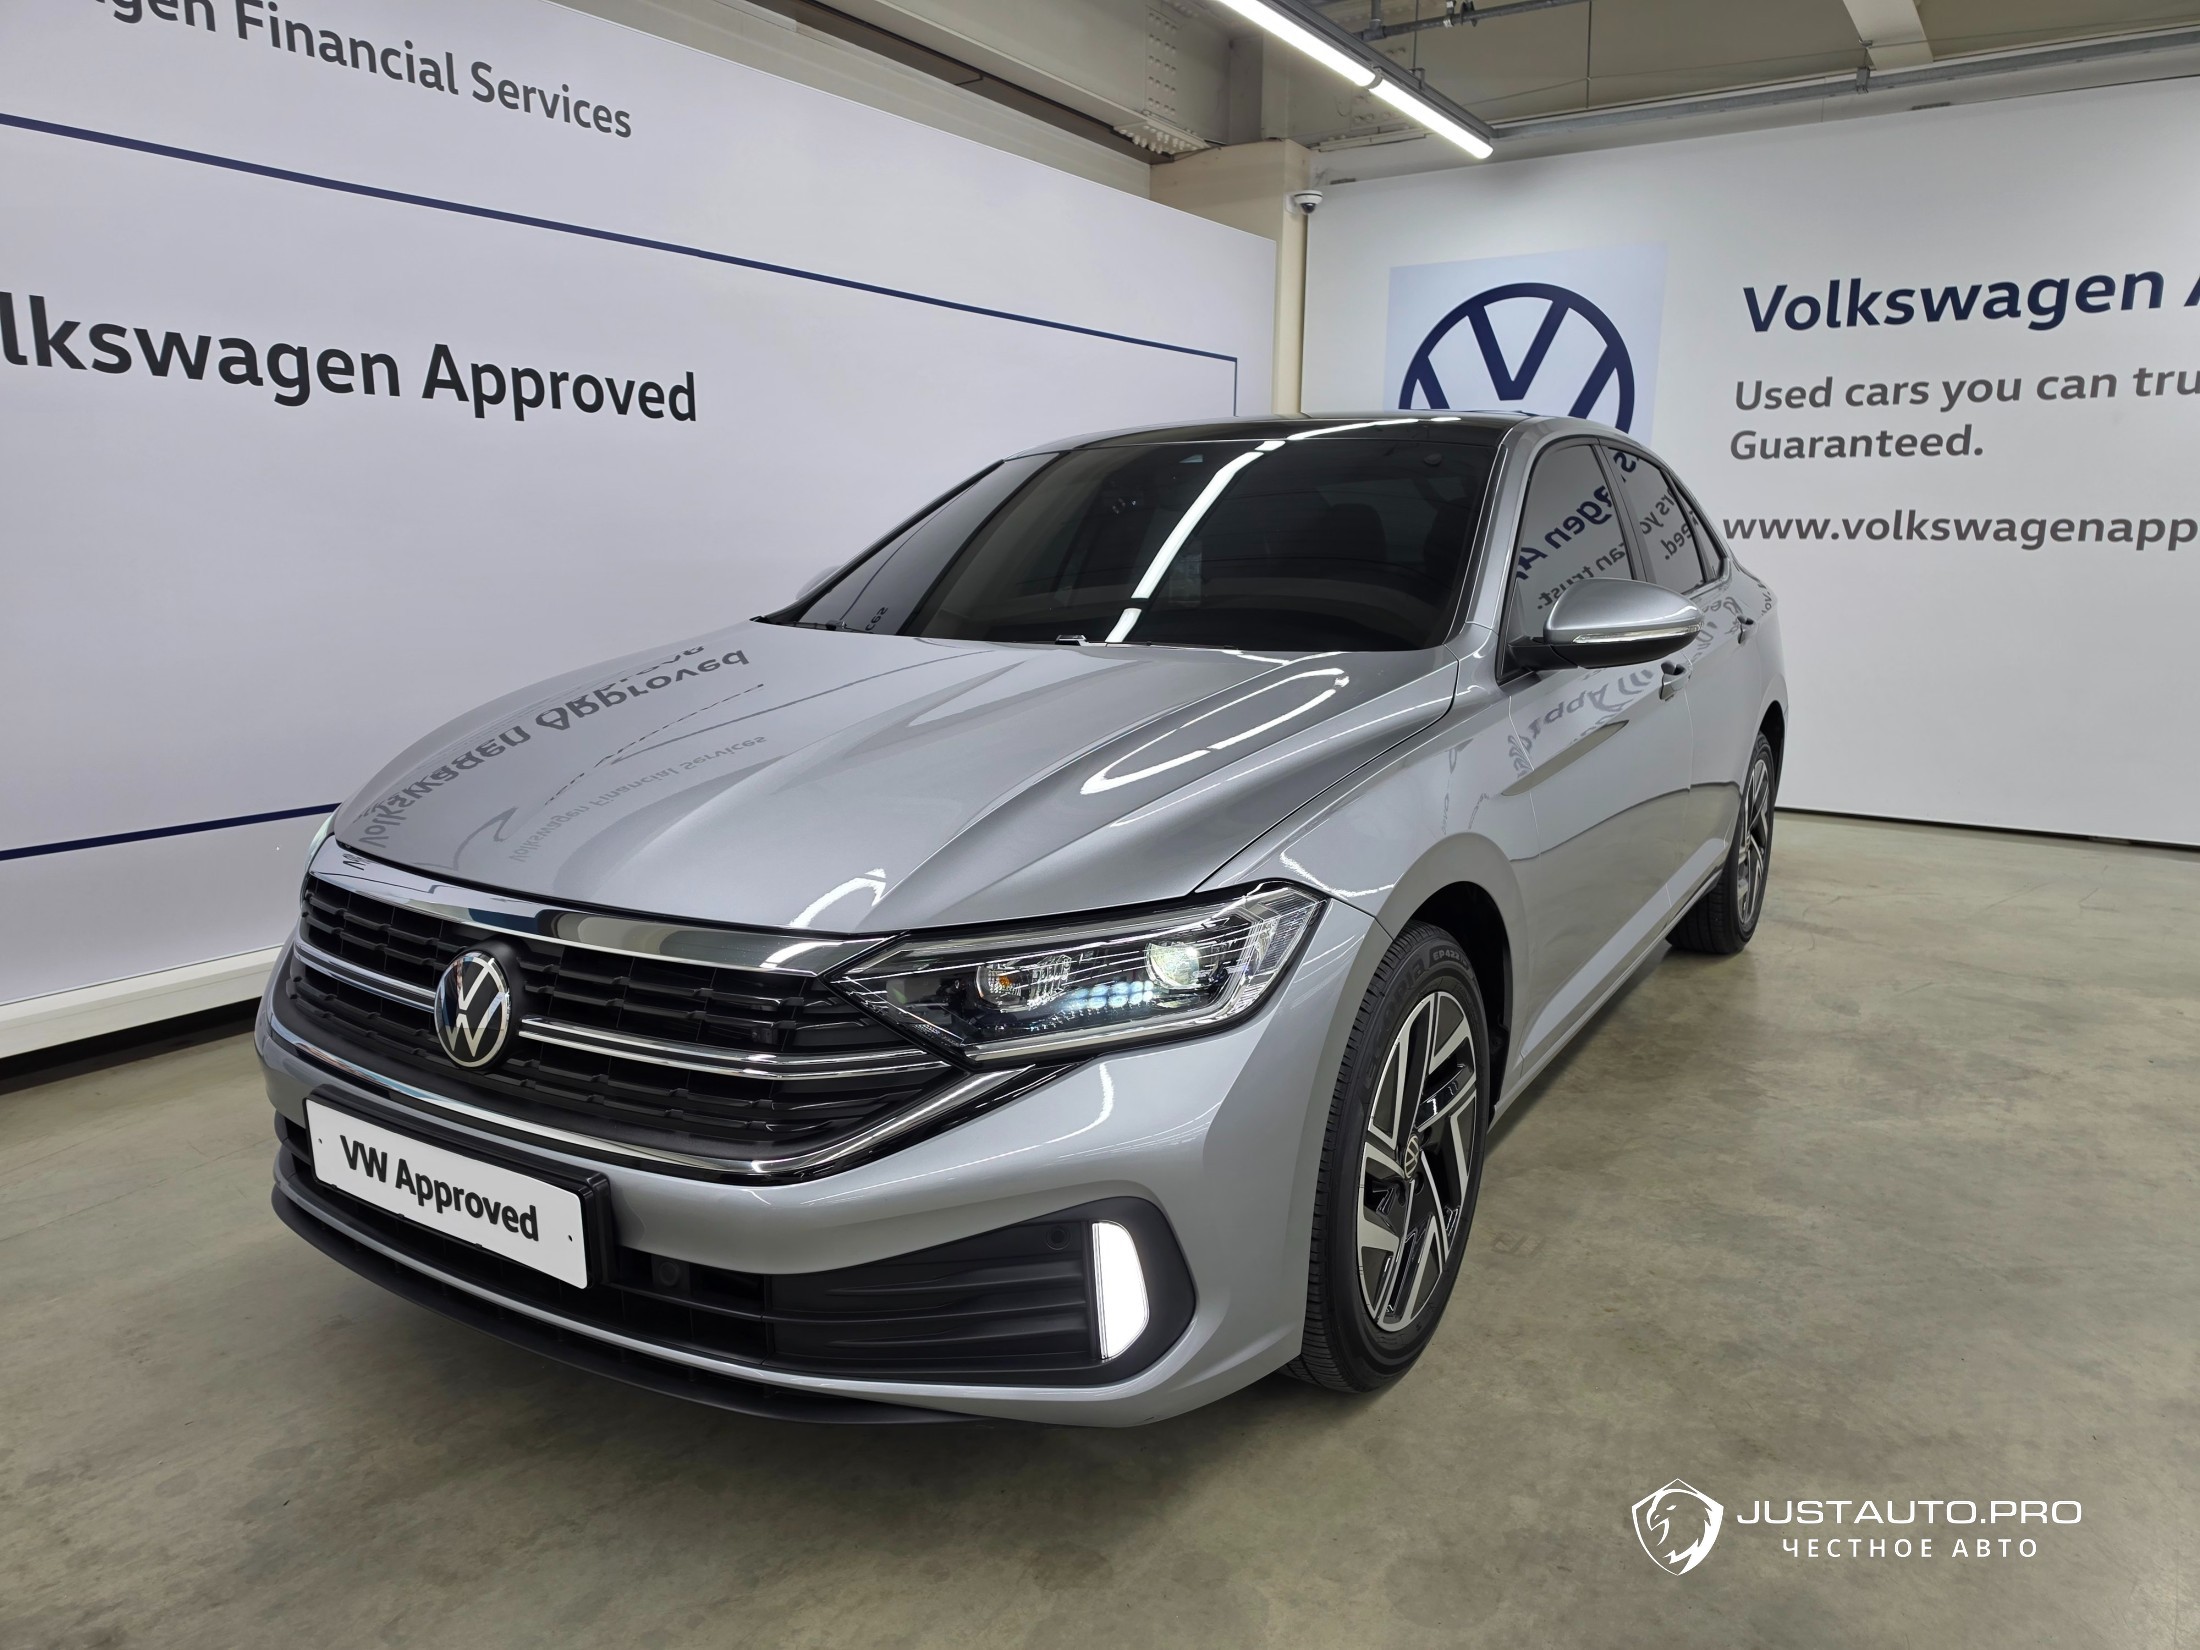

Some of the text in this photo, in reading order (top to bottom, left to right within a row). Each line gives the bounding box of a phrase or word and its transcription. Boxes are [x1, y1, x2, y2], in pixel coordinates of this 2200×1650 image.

[236, 0, 458, 95] Financial
[472, 61, 632, 138] Services
[1742, 270, 2165, 332] Volkswagen
[422, 343, 697, 422] Approved
[1735, 376, 1834, 411] Used
[1845, 377, 1930, 406] cars
[1940, 377, 2022, 412] you
[2036, 372, 2117, 400] can
[1730, 423, 1984, 460] Guaranteed.
[1723, 509, 2198, 551] www.volkswagenapp
[339, 1134, 540, 1242] VW Approved
